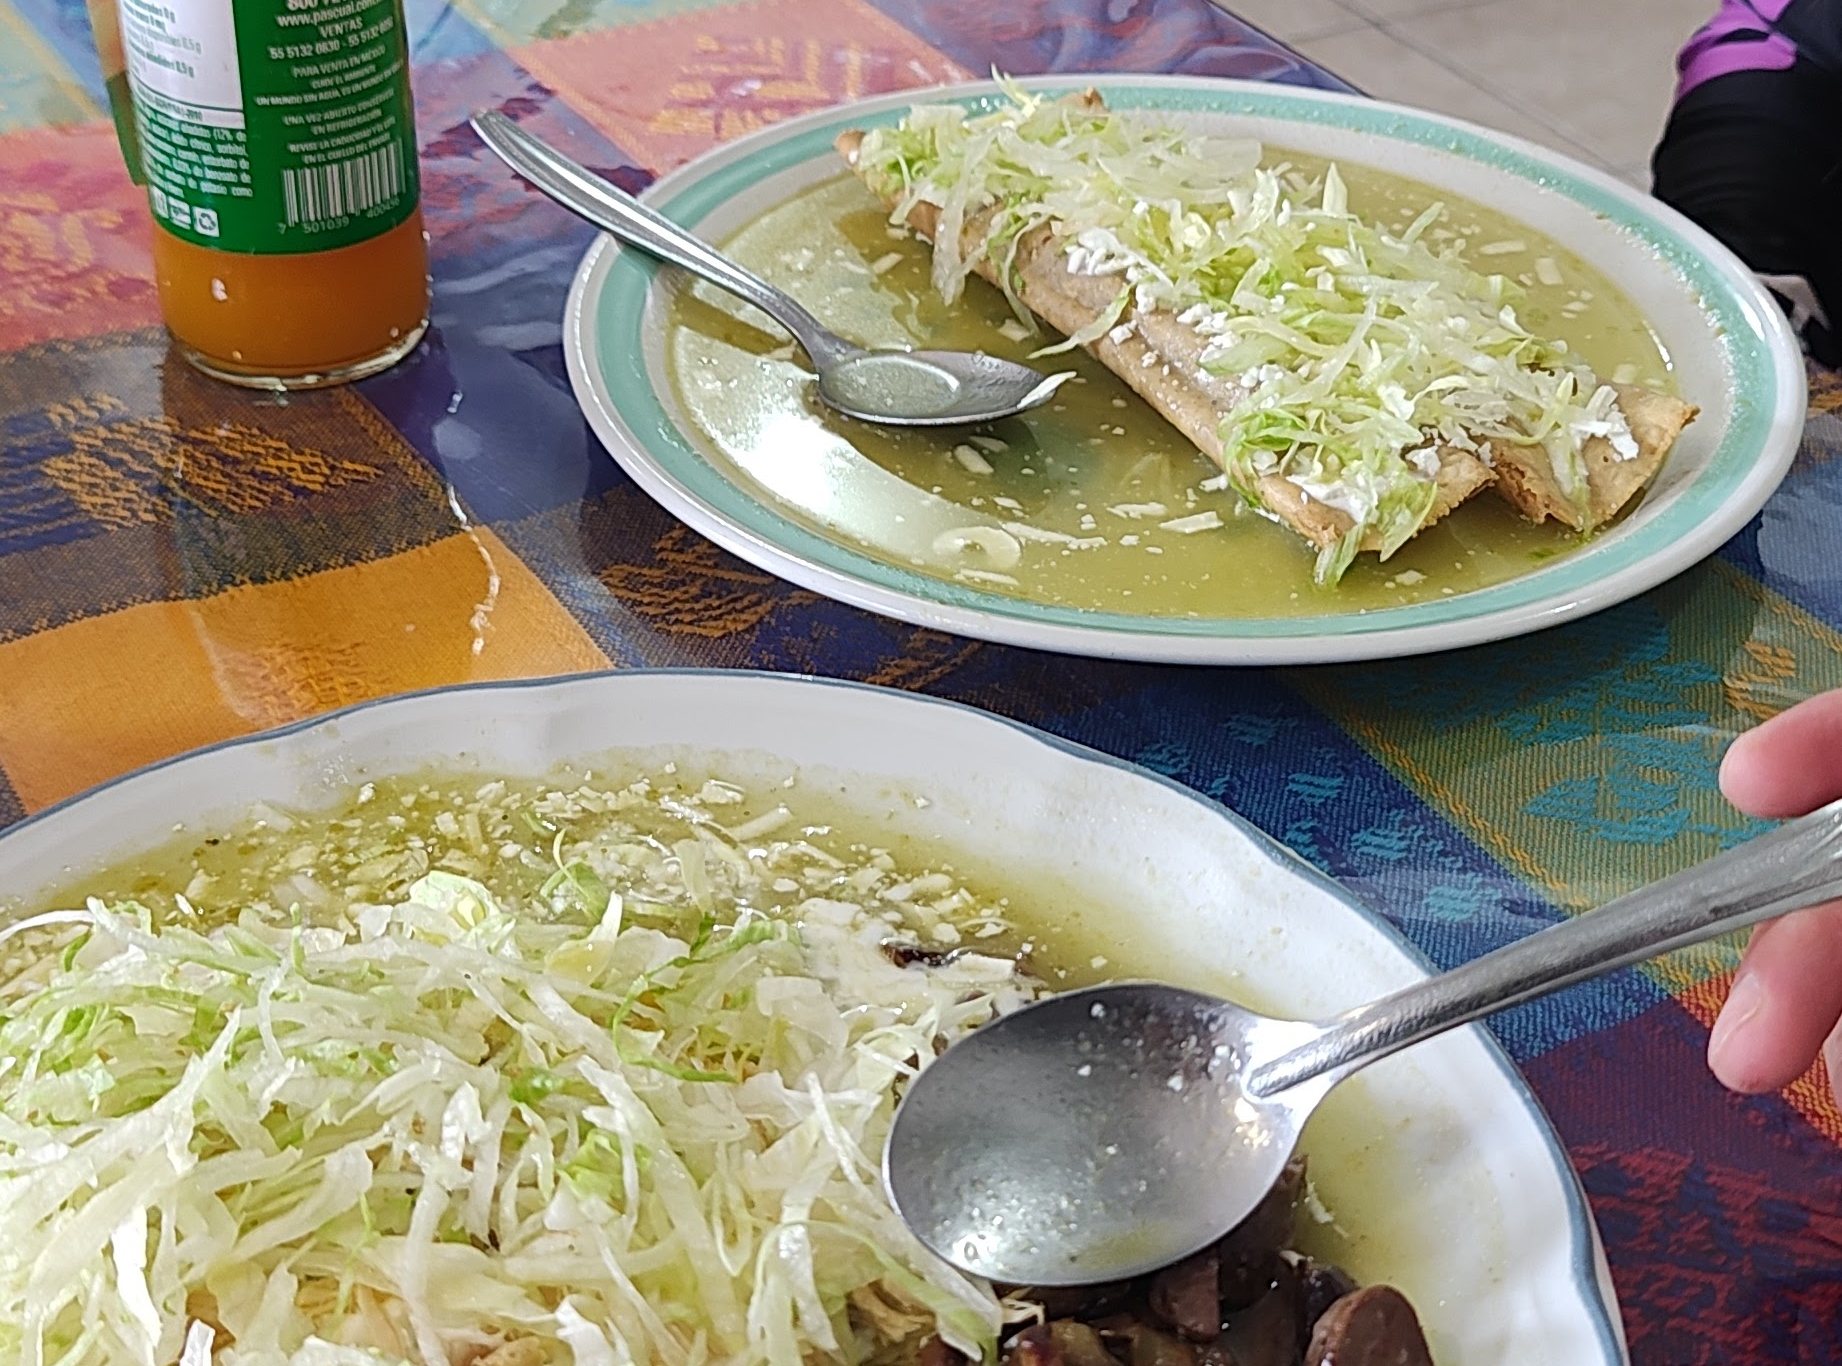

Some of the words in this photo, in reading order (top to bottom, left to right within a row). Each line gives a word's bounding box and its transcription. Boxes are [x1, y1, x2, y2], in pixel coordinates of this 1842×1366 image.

[318, 17, 363, 38] VENTAS
[268, 45, 285, 60] 55
[286, 43, 313, 59] 5132
[291, 65, 320, 78] PARA
[320, 58, 349, 75] VENTA
[270, 93, 303, 106] MUNDO
[301, 215, 350, 234] 501039
